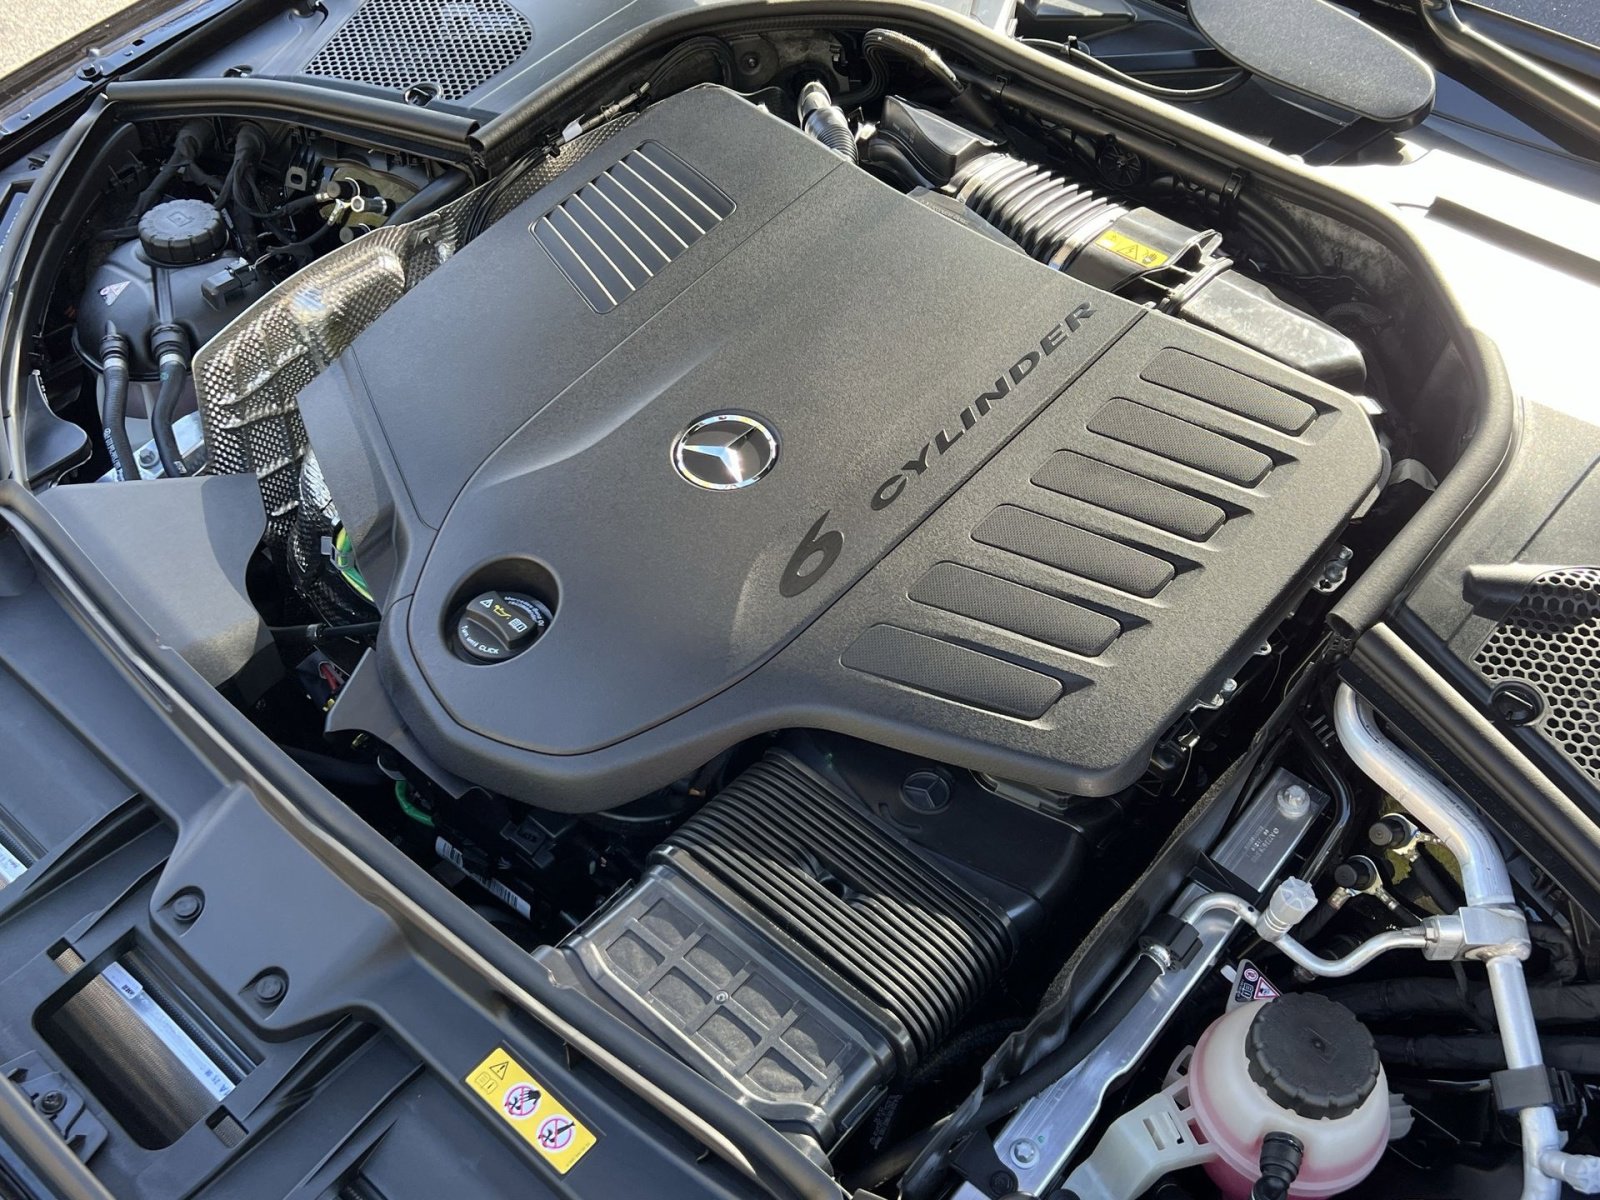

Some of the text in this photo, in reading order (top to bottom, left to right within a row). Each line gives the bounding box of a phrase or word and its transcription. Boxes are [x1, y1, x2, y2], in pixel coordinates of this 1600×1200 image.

[779, 302, 1097, 598] 6 CYLINDER
[479, 644, 499, 654] CLICK
